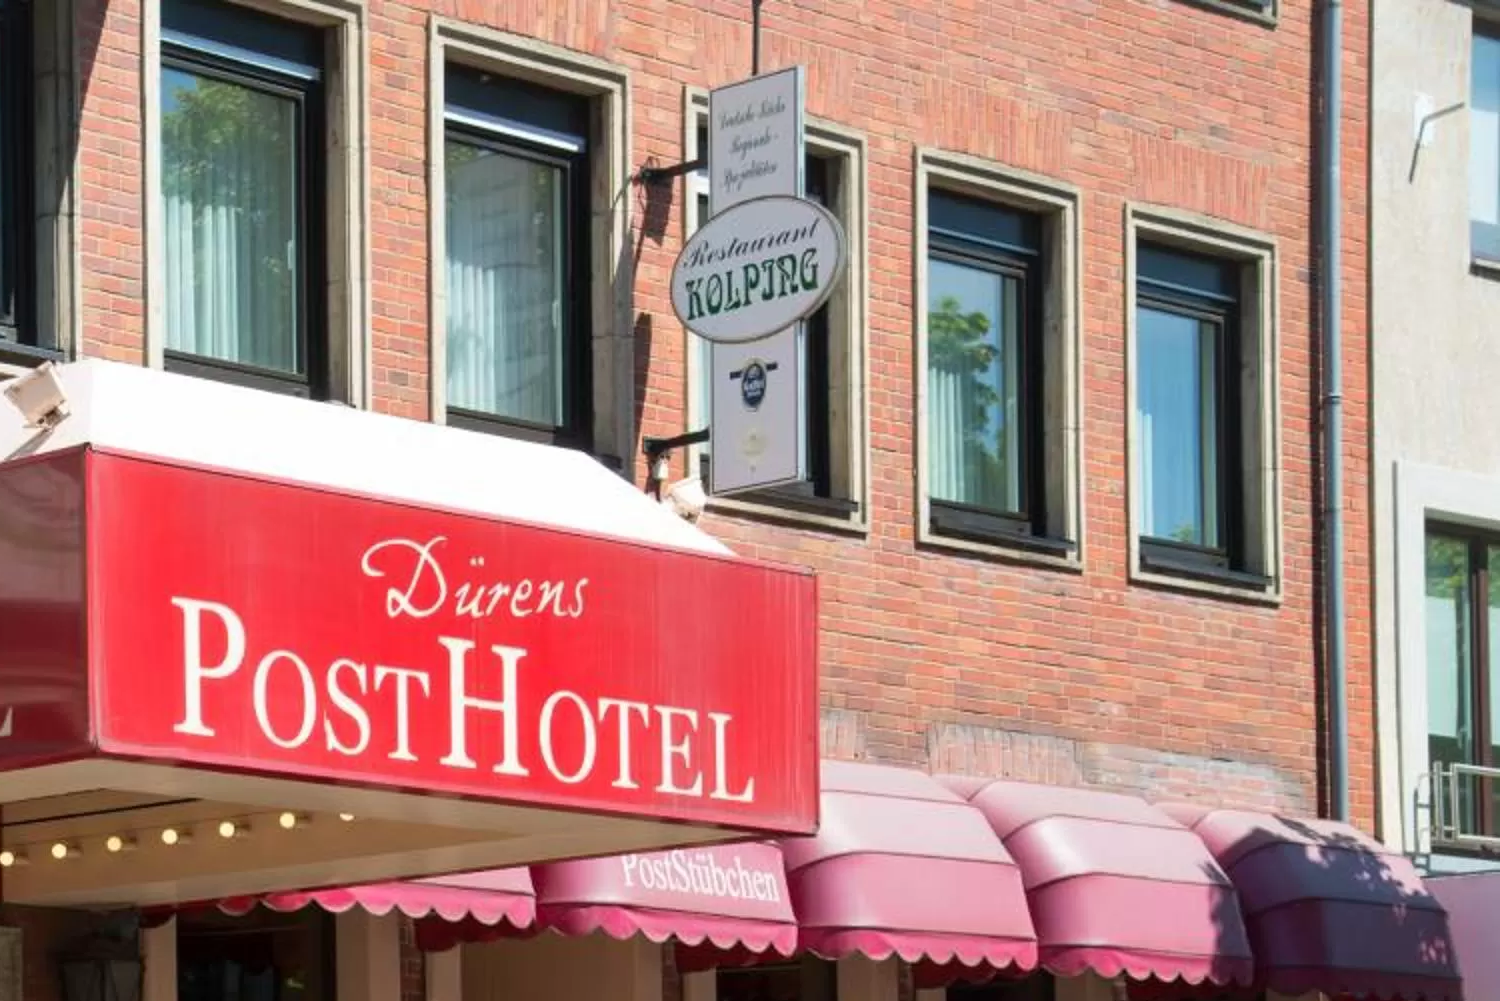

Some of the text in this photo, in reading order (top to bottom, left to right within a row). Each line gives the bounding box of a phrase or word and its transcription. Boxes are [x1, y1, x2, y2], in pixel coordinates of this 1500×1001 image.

[683, 216, 821, 269] Restaurant
[685, 247, 820, 321] KOLPING
[360, 535, 590, 619] Dürens
[620, 849, 781, 902] PostStübchen
